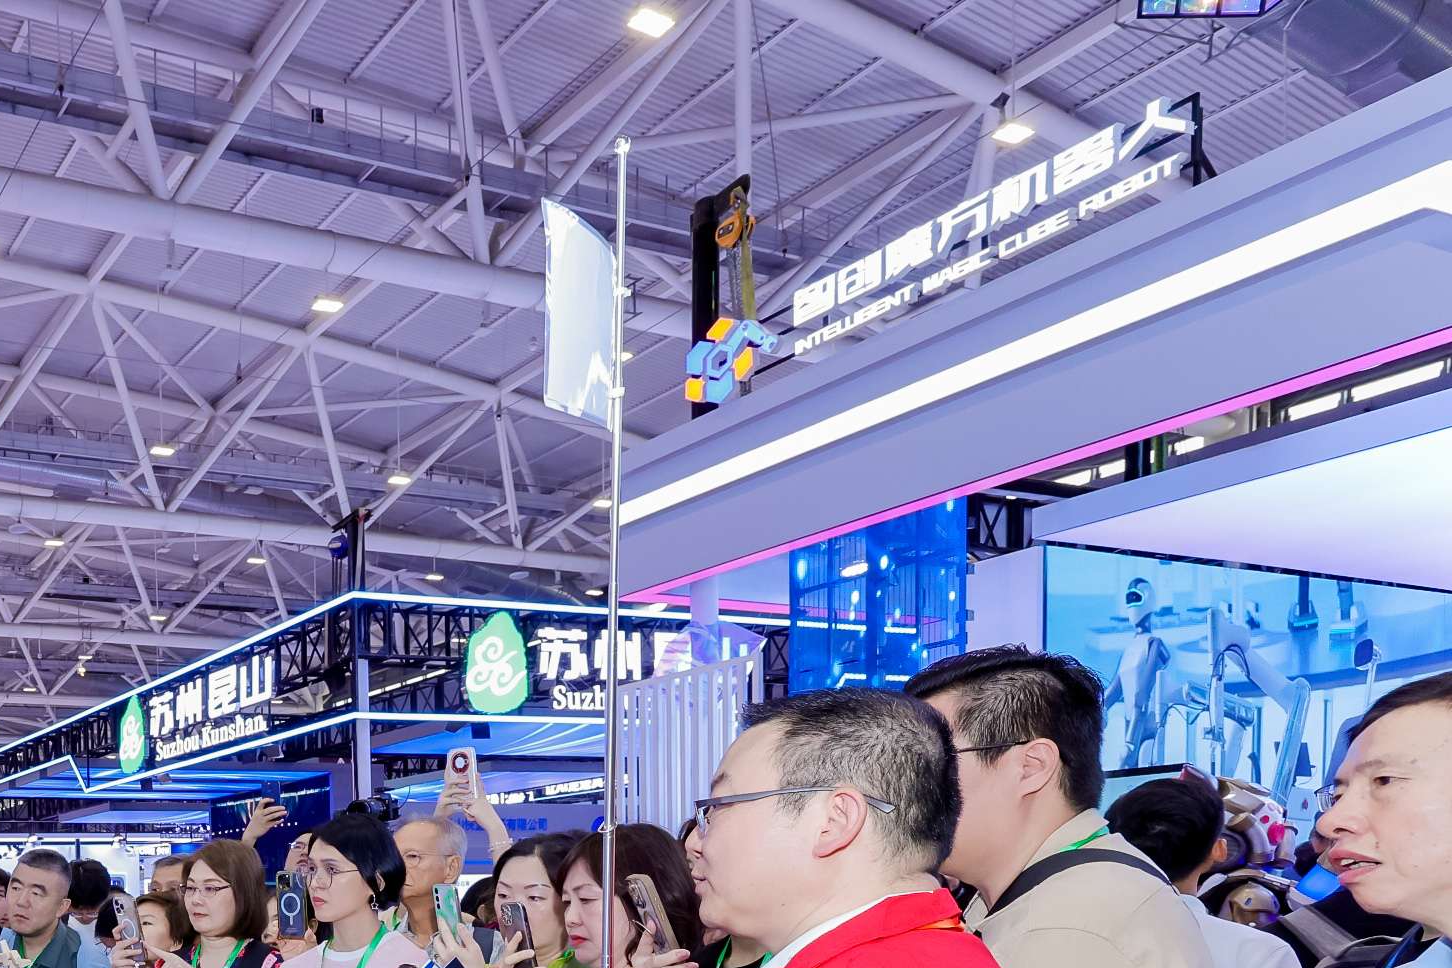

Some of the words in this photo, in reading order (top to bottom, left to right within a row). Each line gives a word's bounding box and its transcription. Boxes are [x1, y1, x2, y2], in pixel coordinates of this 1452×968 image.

[794, 96, 1196, 327] 智创魔方机器人
[795, 282, 919, 356] INTELLIGENT
[922, 246, 997, 295] MAGIC
[998, 208, 1078, 260] CUBE
[1078, 154, 1185, 219] ROBOT
[149, 655, 273, 738] 苏州昆山
[155, 718, 199, 761] Suzhou
[201, 713, 269, 750] Kunshan
